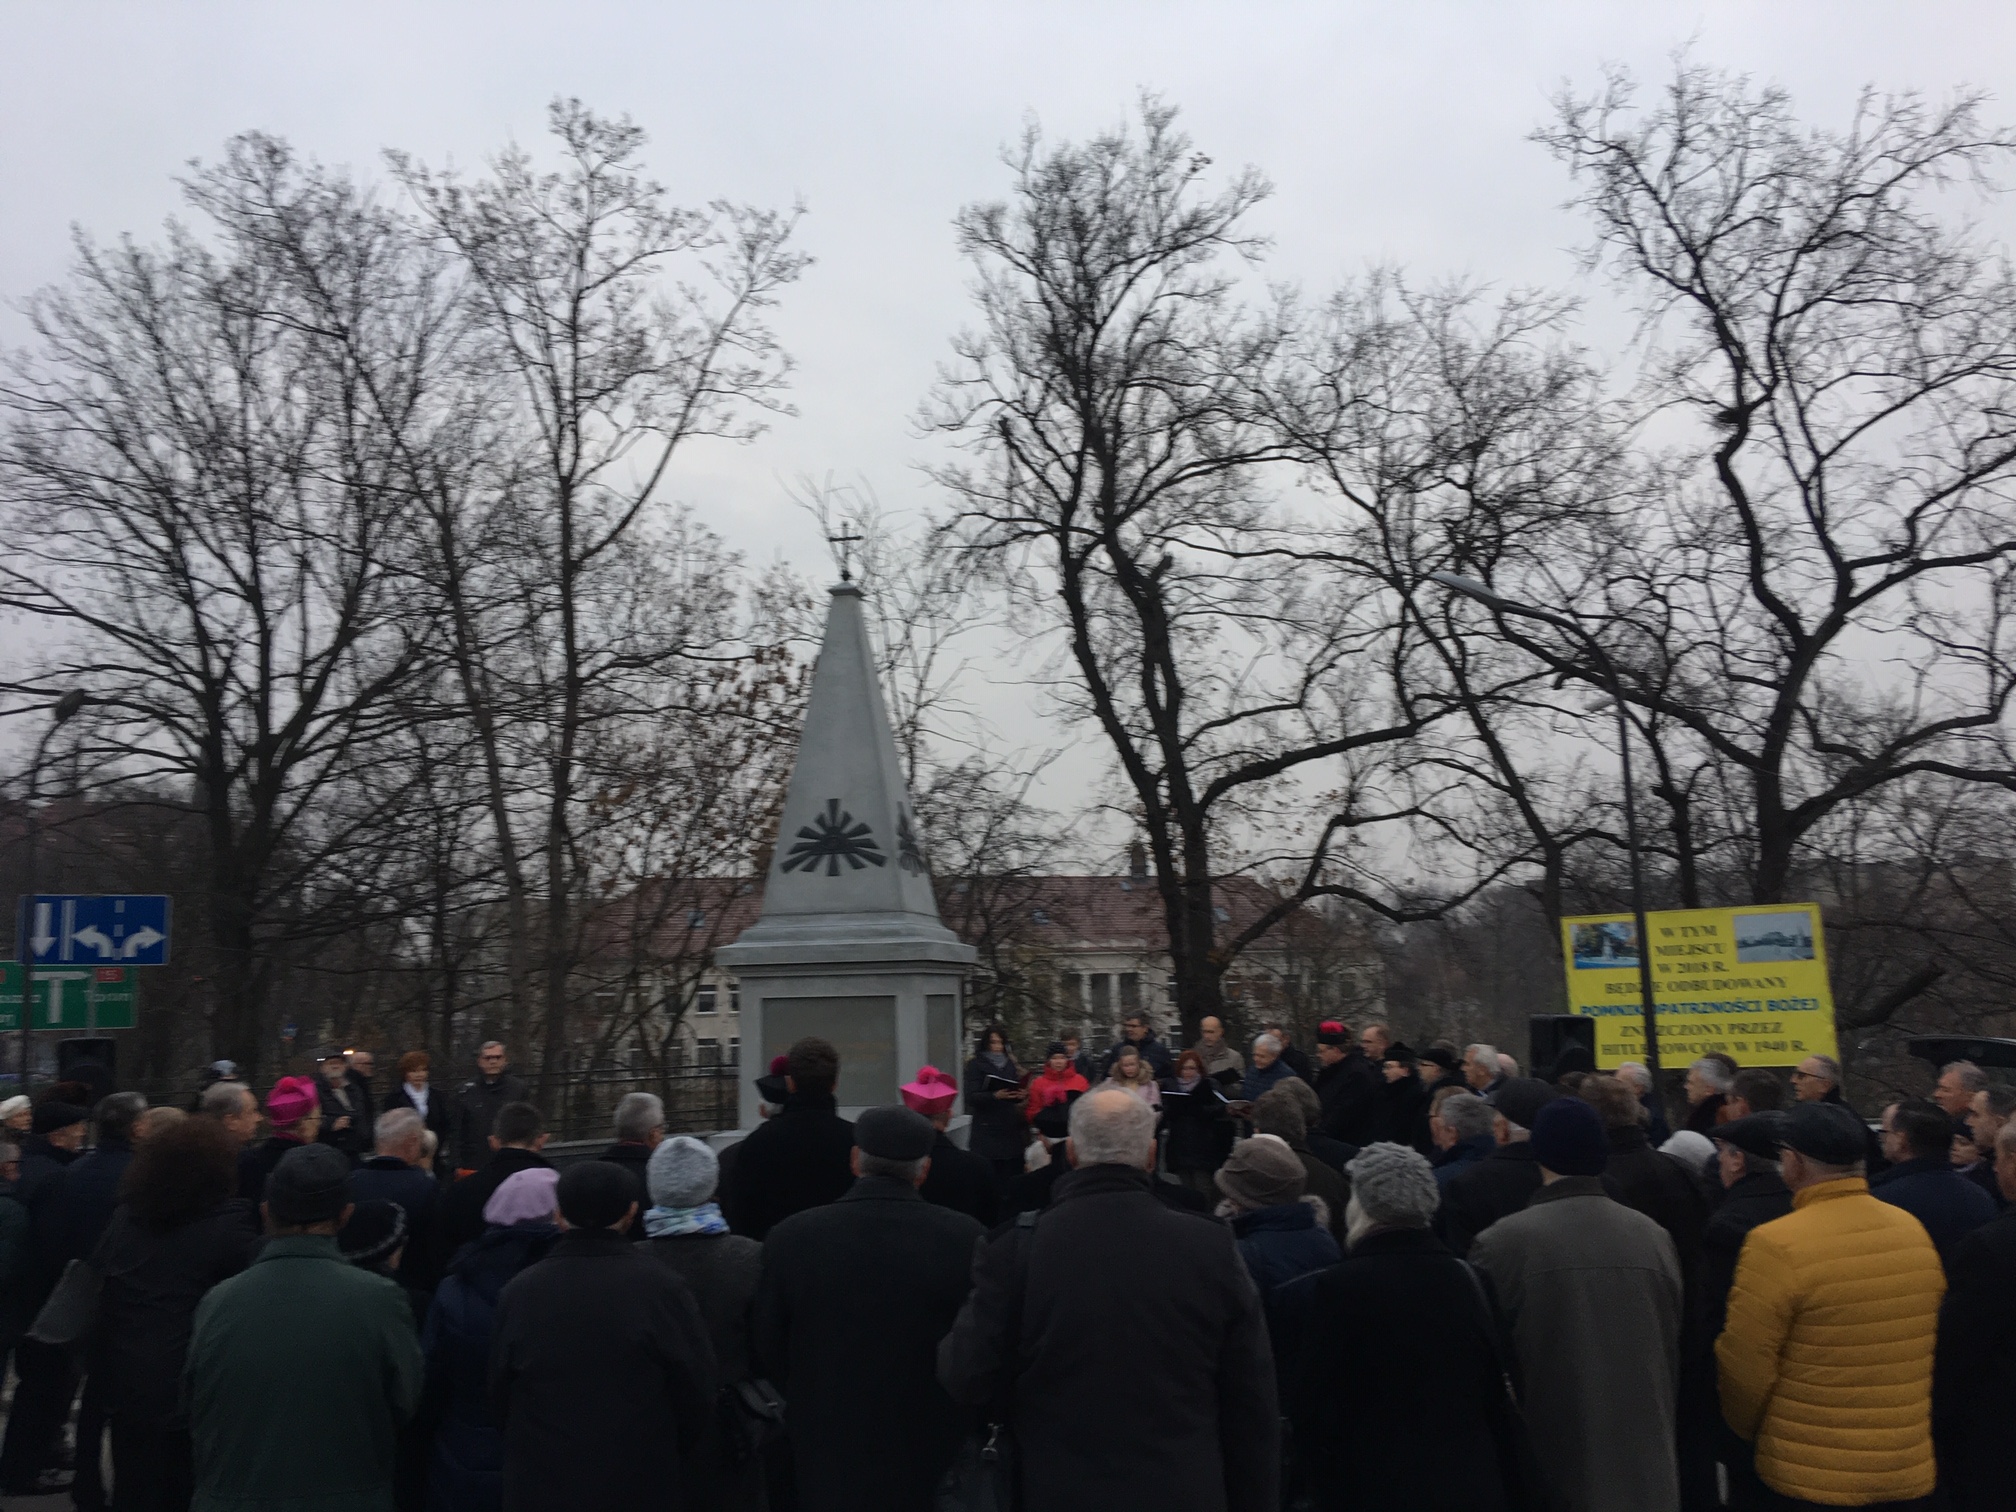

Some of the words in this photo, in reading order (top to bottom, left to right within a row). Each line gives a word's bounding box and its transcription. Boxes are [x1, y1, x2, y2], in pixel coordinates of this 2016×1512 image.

[1659, 927, 1674, 937] W
[1681, 925, 1718, 937] TYM
[1655, 943, 1727, 956] MIEJSCU
[1657, 963, 1672, 973] W
[1605, 981, 1664, 996] BĘDZE
[1667, 977, 1788, 992] ODBUDOWANY
[1580, 1004, 1646, 1017] POMNIK
[1766, 996, 1820, 1012] BOŻEJ
[1619, 1023, 1724, 1038] ZNZCZONY
[1727, 1022, 1785, 1035] PRZEZ
[1601, 1039, 1729, 1056] HITLEOWCÓW
[1734, 1041, 1748, 1052] W
